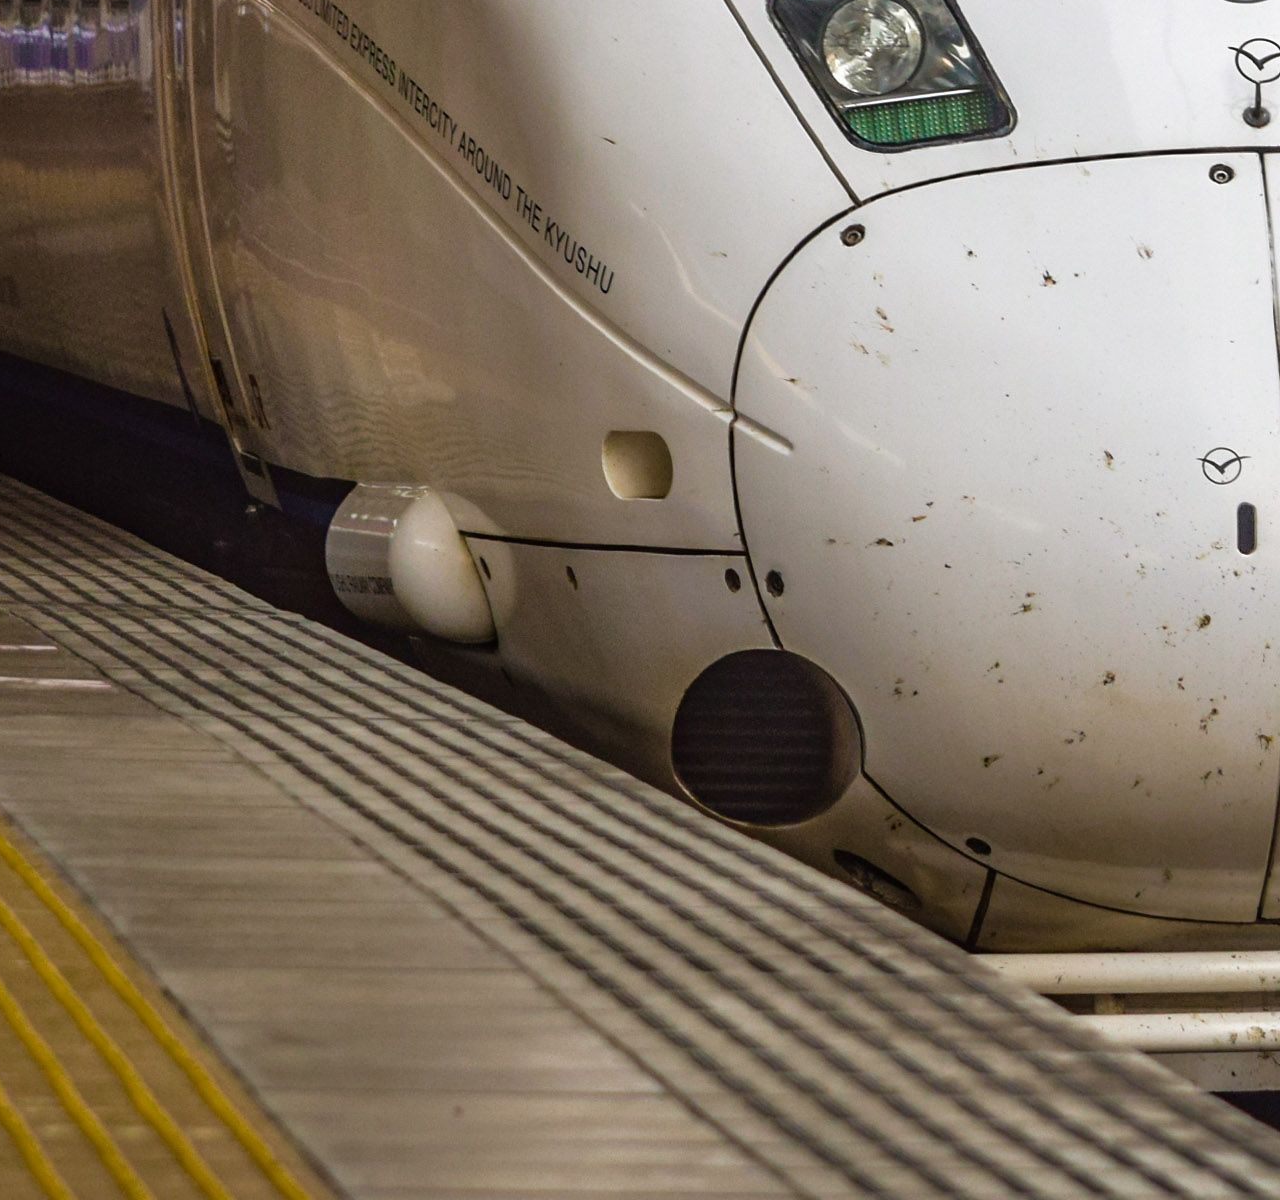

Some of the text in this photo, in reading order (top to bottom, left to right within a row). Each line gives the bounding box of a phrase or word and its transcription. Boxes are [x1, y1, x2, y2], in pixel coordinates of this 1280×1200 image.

[350, 23, 396, 87] EXPRESS
[398, 70, 458, 145] INTERCITY
[458, 132, 511, 201] AROUND
[516, 185, 542, 233] THE
[544, 216, 615, 295] KYUSHU
